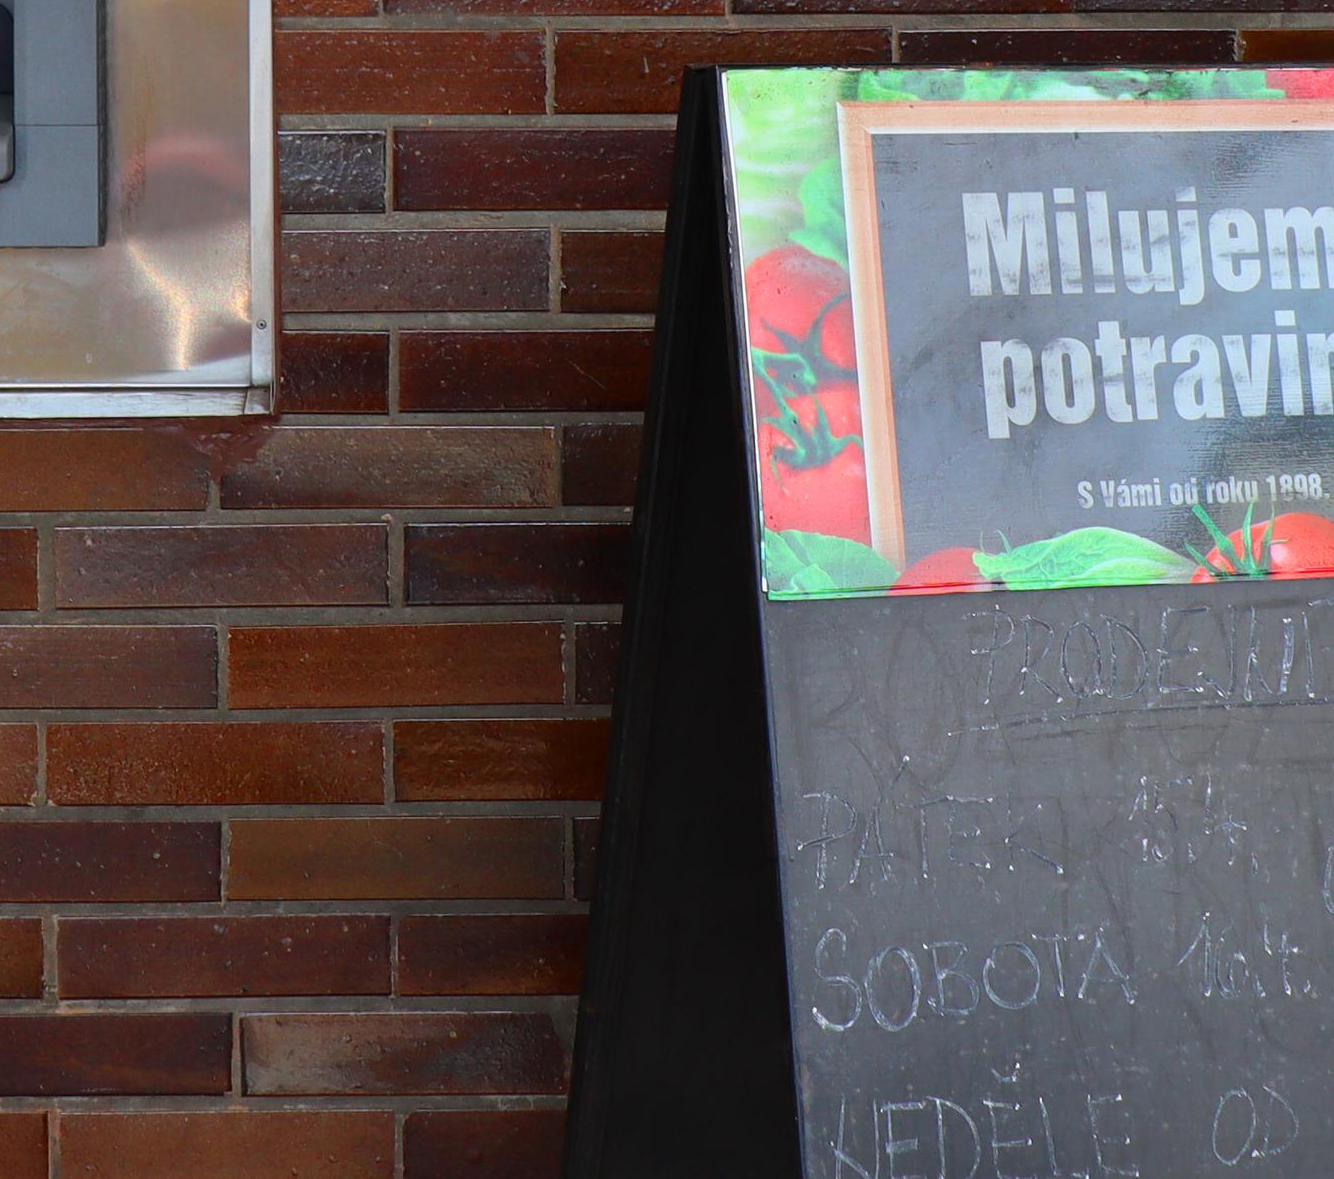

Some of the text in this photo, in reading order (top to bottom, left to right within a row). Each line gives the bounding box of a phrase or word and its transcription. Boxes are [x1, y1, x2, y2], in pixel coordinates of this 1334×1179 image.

[1077, 472, 1331, 509] S Vámi od roku 1898.
[797, 756, 1065, 889] PÁTEK
[813, 927, 1136, 1033] SOBOTA
[830, 1061, 1140, 1179] NEDĚLE
[1213, 1086, 1300, 1166] OD
